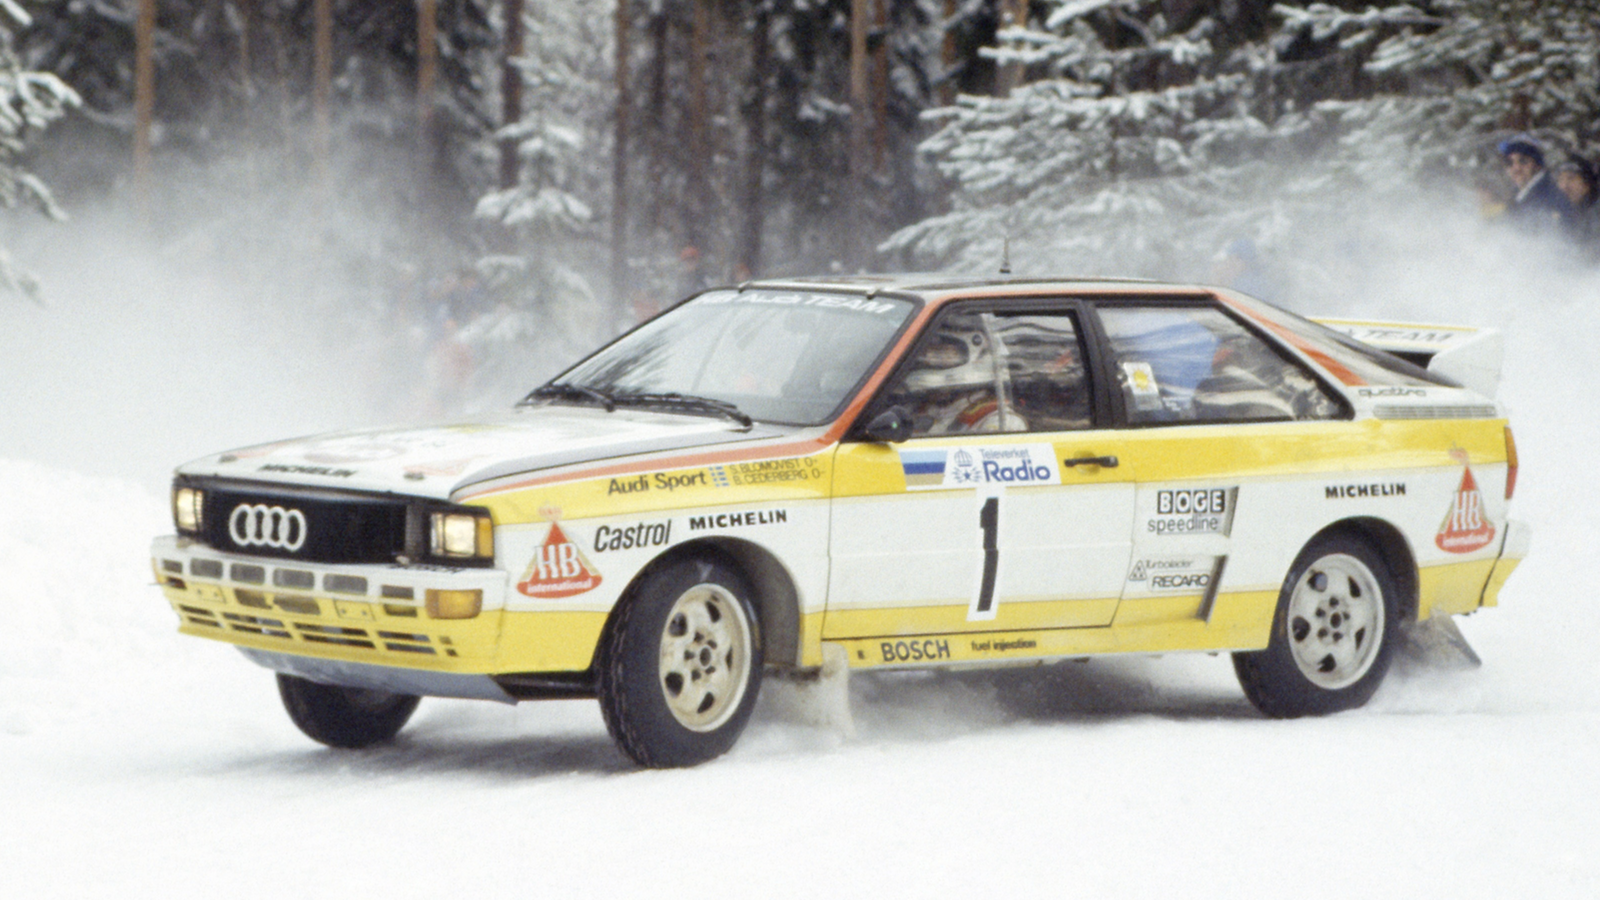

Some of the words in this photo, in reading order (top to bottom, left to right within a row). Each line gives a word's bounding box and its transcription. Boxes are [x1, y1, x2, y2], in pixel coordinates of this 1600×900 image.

[805, 295, 896, 314] TEAM
[1363, 329, 1454, 341] TEAM
[1358, 387, 1427, 398] quattro
[979, 448, 1029, 460] Televerket
[260, 464, 356, 477] MICHELIN
[982, 459, 1051, 482] Radio
[608, 477, 650, 496] Audi
[654, 471, 707, 493] Sport
[1325, 482, 1407, 499] MICHELIN
[1157, 489, 1225, 514] BOGE
[1452, 490, 1482, 532] HB
[689, 509, 788, 529] MICHELIN
[1147, 516, 1219, 535] speedline
[594, 519, 672, 554] Castrol
[534, 542, 582, 580] HB
[977, 497, 999, 612] 1
[526, 577, 593, 595] international
[1152, 573, 1210, 588] RECARO
[881, 639, 951, 662] BOSCH
[971, 640, 991, 651] fuel
[993, 638, 1037, 652] injection
